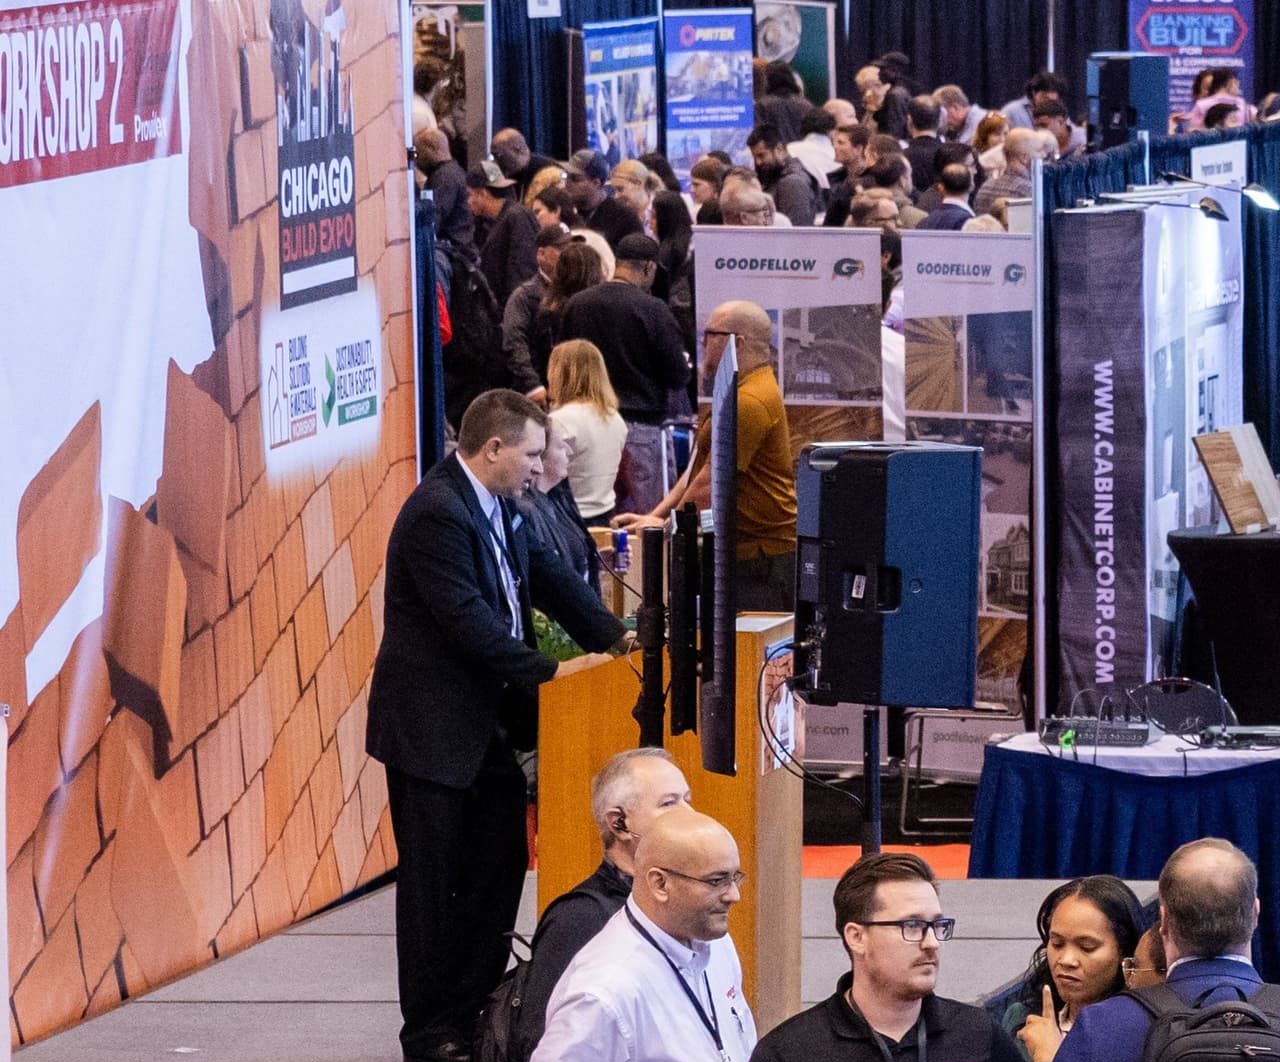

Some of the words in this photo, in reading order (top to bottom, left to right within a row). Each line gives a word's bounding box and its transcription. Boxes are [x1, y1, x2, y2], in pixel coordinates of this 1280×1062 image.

[1150, 14, 1234, 28] BANKING
[1150, 27, 1234, 47] BUILT
[109, 18, 125, 145] 2
[281, 155, 353, 219] CHICAGO
[283, 221, 317, 264] BUILD
[319, 212, 355, 256] EXPO
[714, 257, 817, 272] GOODFELLOW
[916, 262, 993, 278] GOODFELLOW
[1093, 360, 1116, 684] WWW.CABINETCORP.COM
